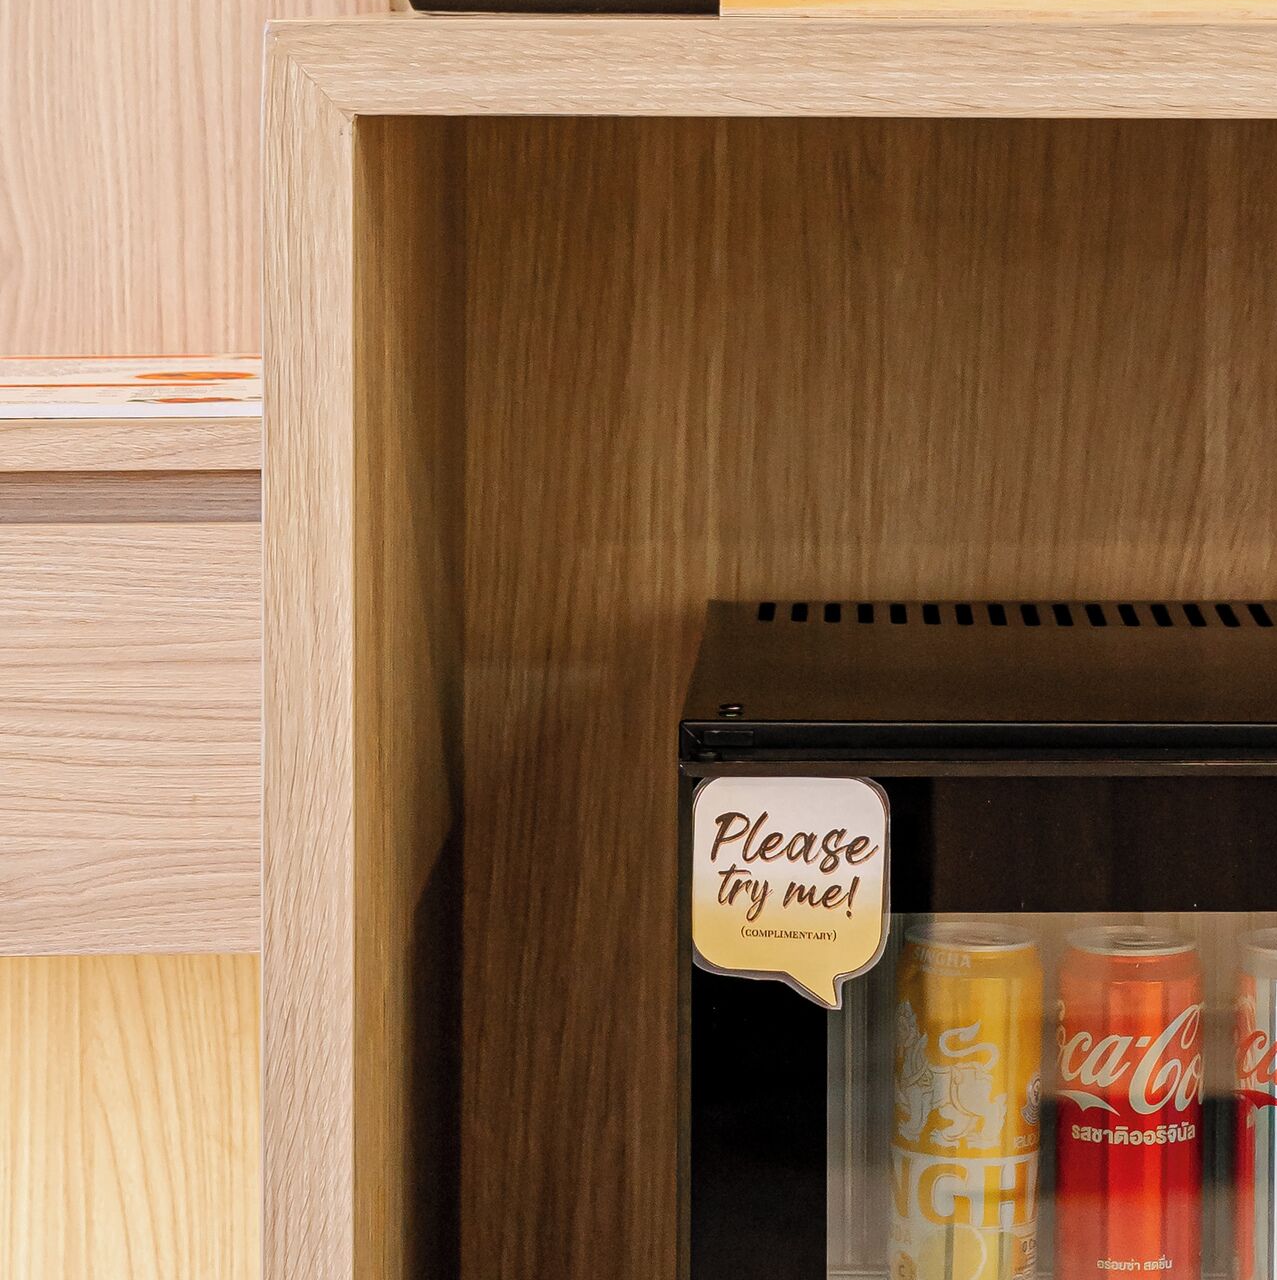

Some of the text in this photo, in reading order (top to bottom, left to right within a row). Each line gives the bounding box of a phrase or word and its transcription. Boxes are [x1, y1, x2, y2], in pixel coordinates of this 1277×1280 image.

[710, 811, 879, 875] Please
[718, 863, 861, 922] try me!
[740, 926, 837, 942] (COMPLIMENTARY)
